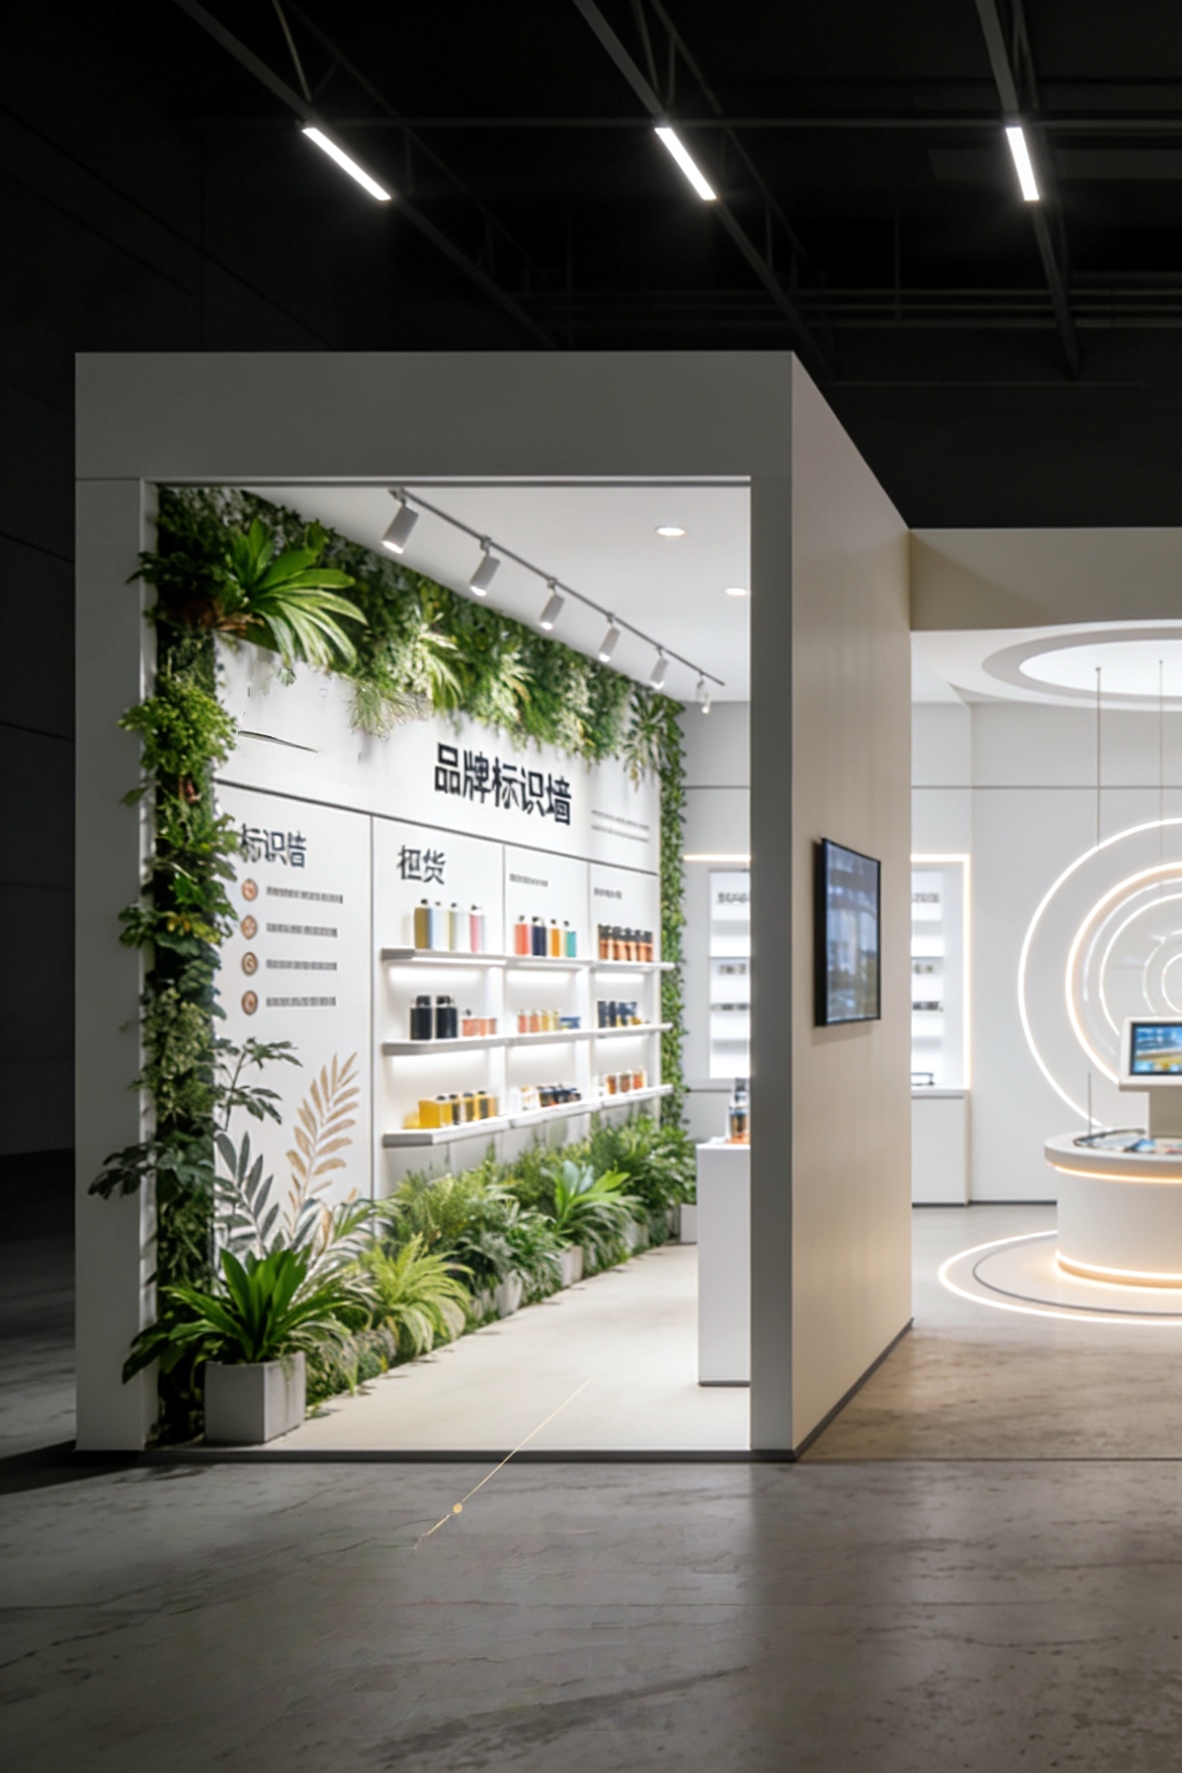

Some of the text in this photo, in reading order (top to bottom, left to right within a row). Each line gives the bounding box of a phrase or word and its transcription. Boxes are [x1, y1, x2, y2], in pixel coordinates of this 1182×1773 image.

[434, 742, 572, 826] 品牌标识墙
